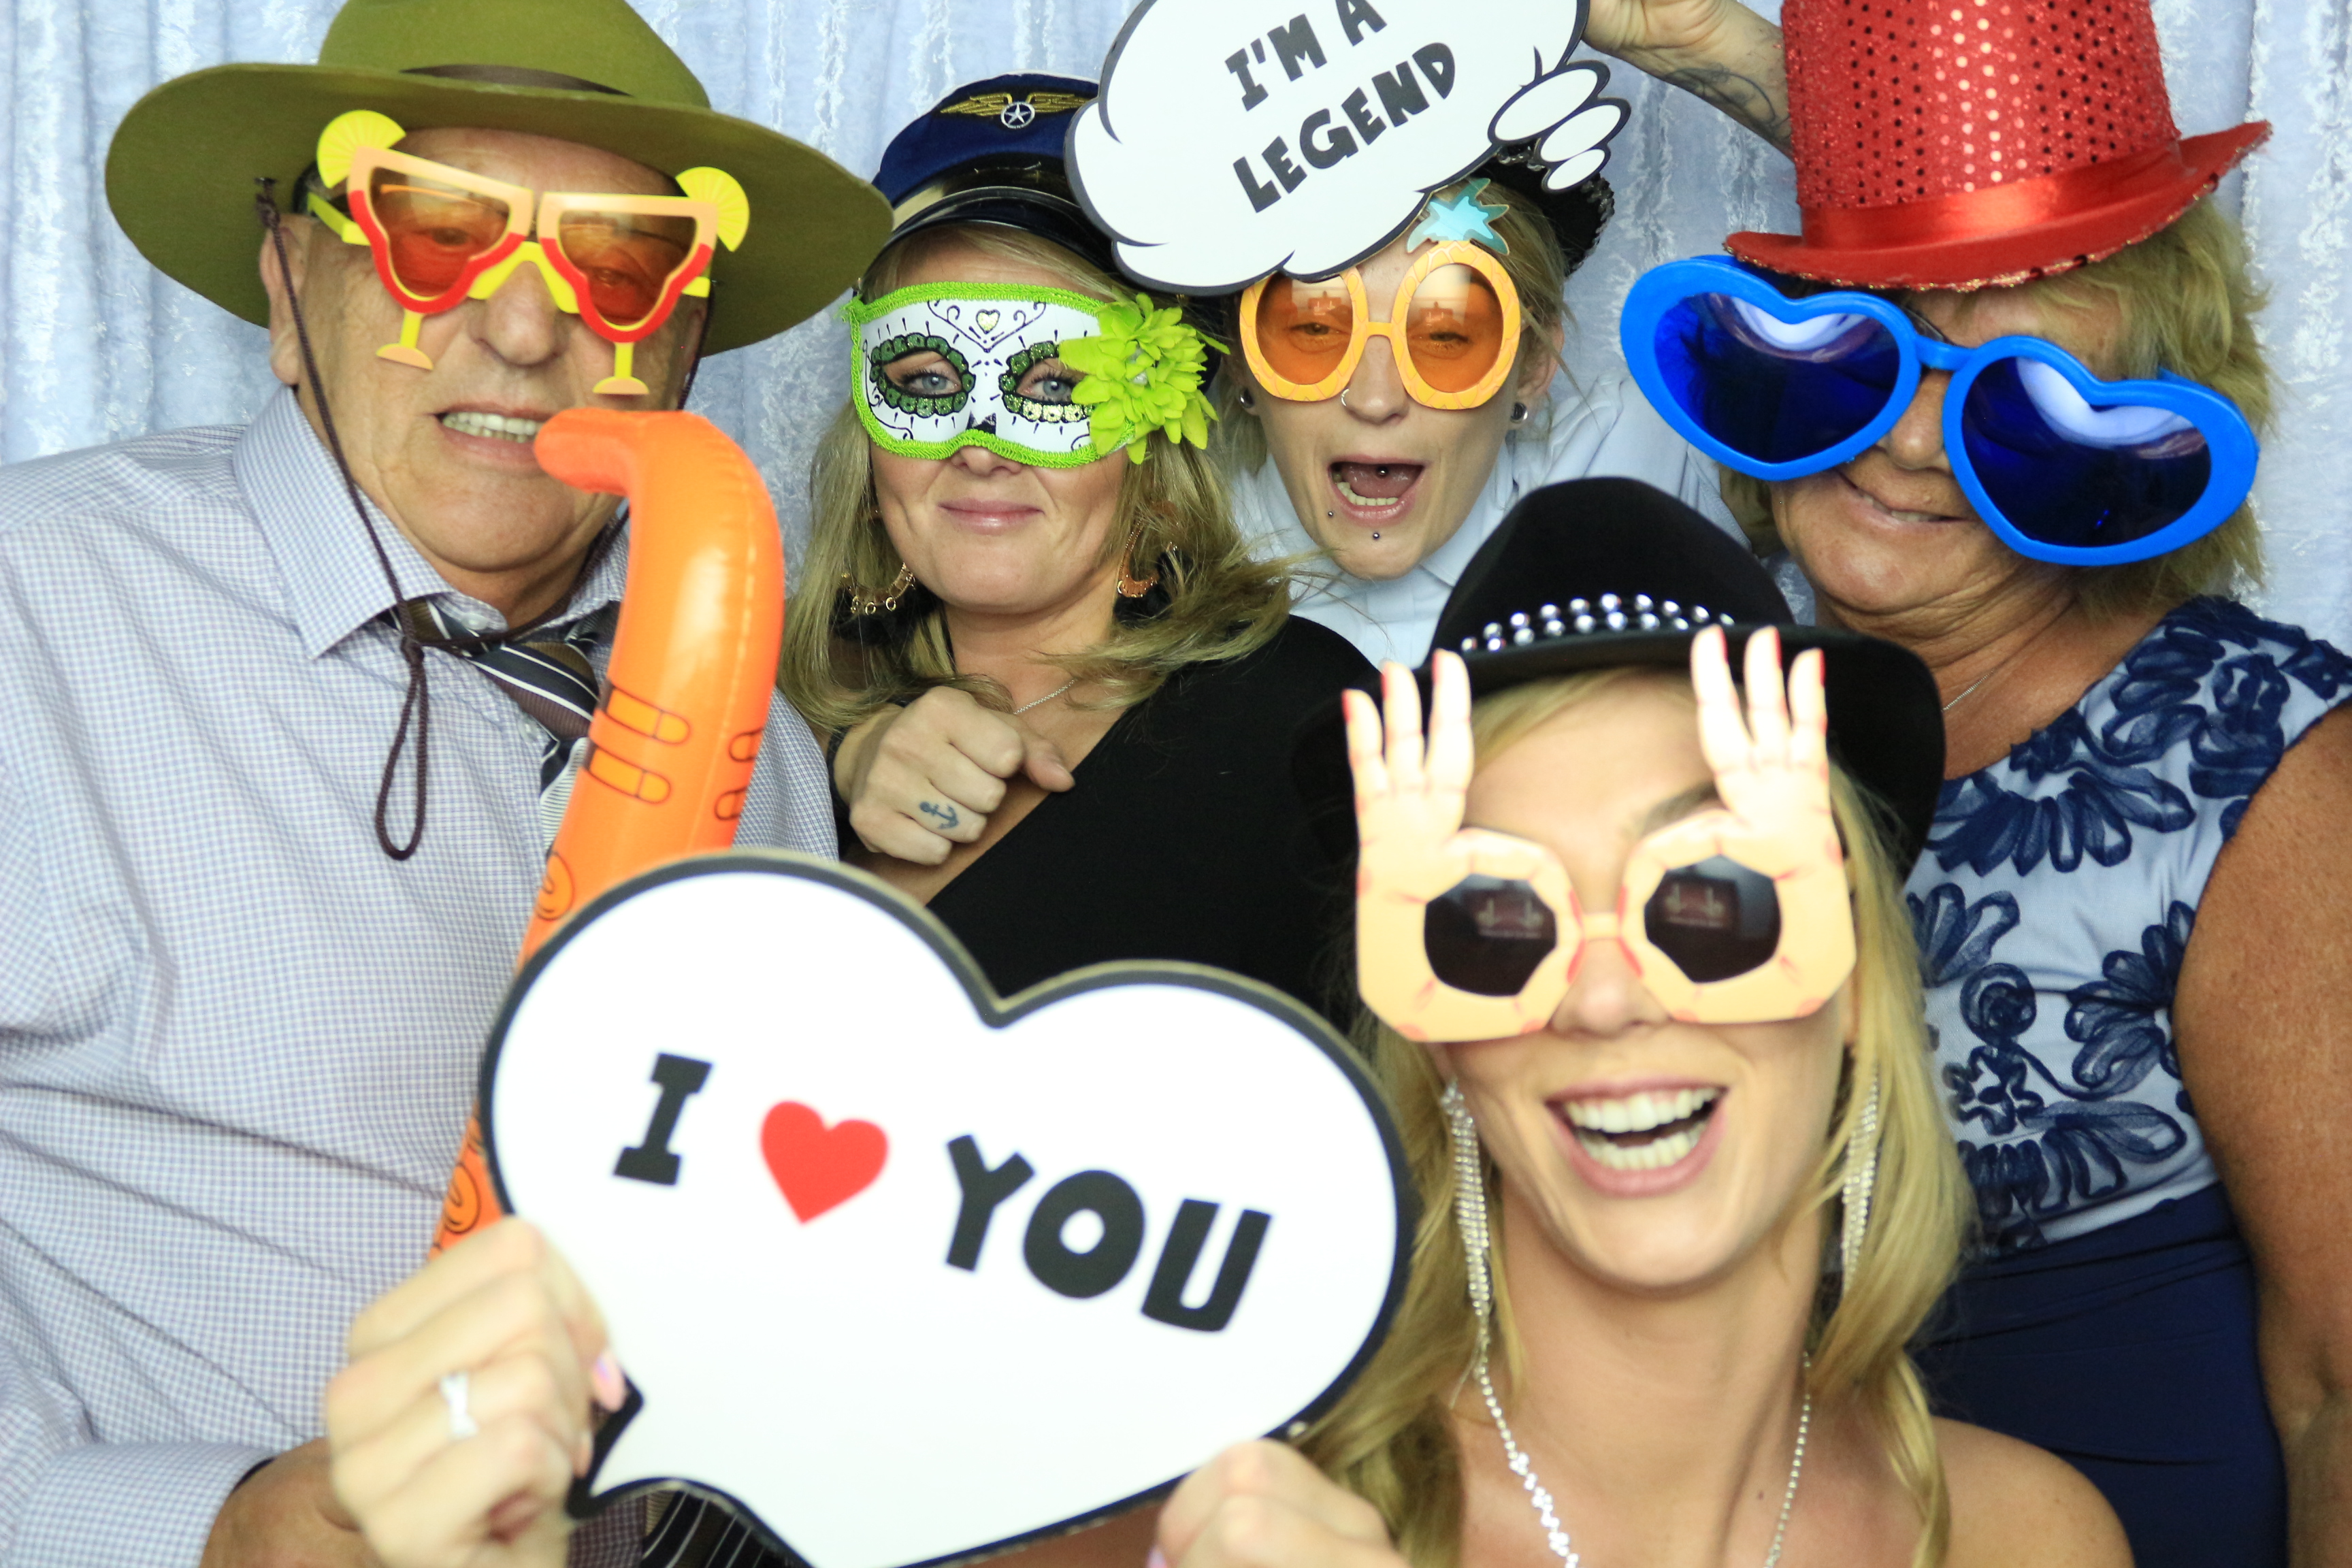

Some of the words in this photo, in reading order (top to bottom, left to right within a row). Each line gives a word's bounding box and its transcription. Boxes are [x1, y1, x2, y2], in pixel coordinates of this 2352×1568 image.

[1226, 14, 1326, 111] I'M
[1336, 0, 1386, 46] A
[1233, 43, 1455, 212] LEGEND
[615, 1054, 711, 1185] I
[947, 1135, 1271, 1332] YOU
